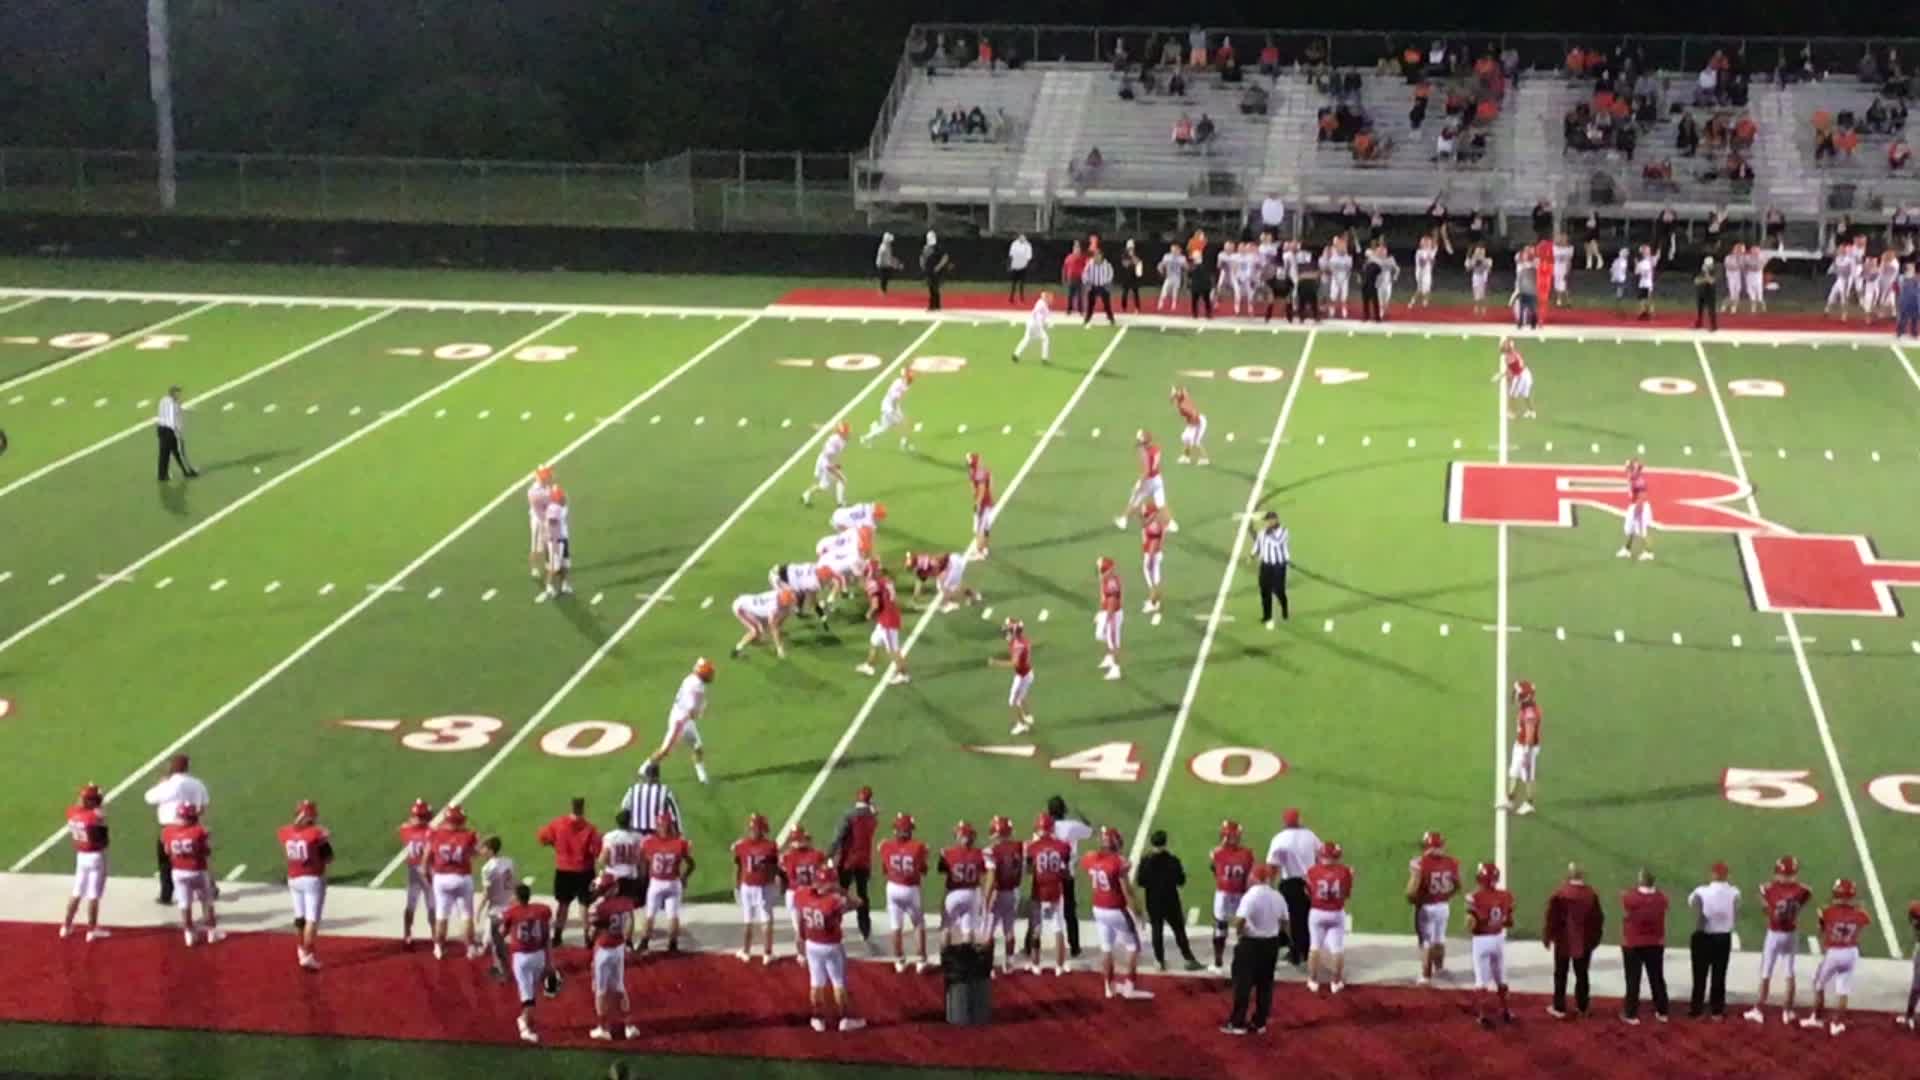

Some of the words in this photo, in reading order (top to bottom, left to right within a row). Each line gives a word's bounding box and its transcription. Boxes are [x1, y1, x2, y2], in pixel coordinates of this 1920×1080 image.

[401, 715, 633, 757] 30
[1049, 742, 1285, 786] 40
[438, 844, 463, 864] 54
[652, 853, 674, 875] 67
[1430, 872, 1454, 894] 55
